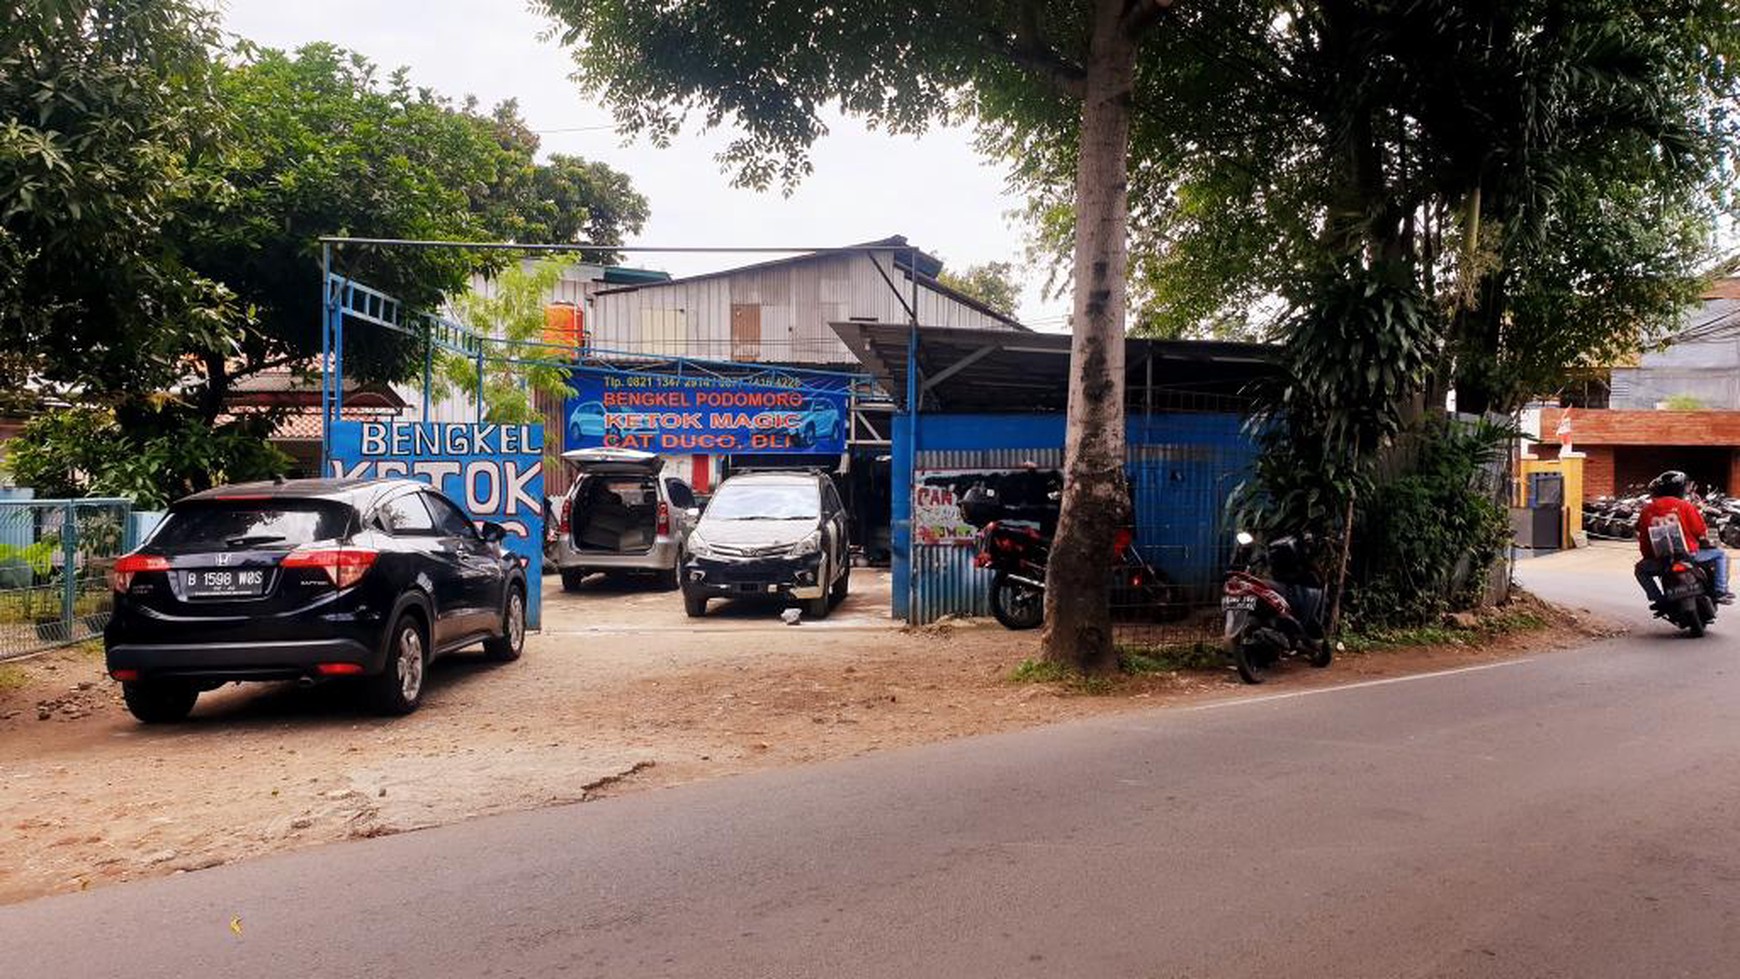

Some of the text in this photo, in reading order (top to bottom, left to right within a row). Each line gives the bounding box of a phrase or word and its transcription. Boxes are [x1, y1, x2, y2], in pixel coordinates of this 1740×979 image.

[604, 391, 803, 407] BENGKEL PODOMORO
[604, 412, 800, 429] KETOK MAGIC
[361, 422, 543, 456] BENGKEL
[603, 434, 655, 448] CAT
[188, 572, 196, 586] B
[203, 572, 232, 586] 1598
